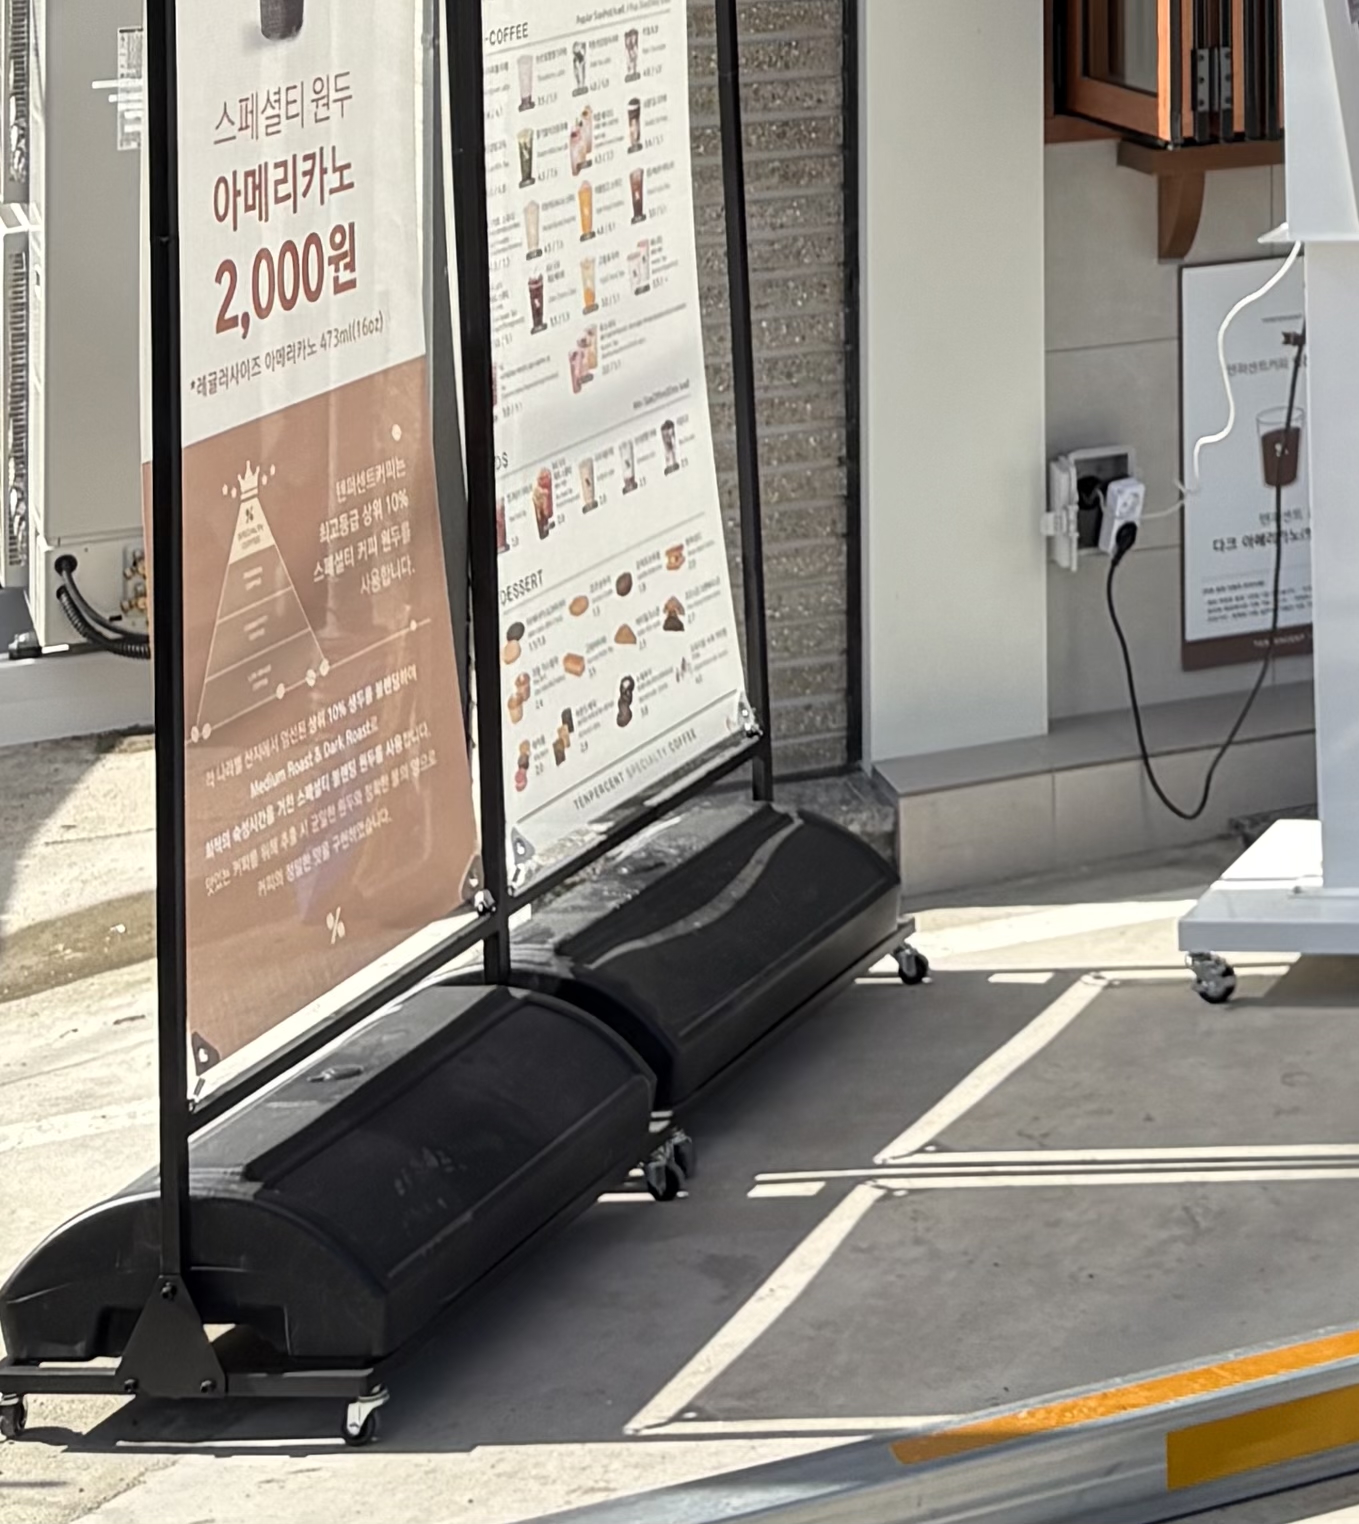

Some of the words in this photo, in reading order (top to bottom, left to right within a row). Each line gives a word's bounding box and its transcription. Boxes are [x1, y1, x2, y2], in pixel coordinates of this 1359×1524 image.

[213, 80, 304, 146] 스페셜티
[310, 70, 354, 122] 원두
[213, 144, 356, 233] 아메리카노
[214, 220, 358, 340] 2,000원
[264, 338, 318, 372] 아메리카노
[385, 488, 410, 515] 10%
[357, 530, 379, 562] 커피
[249, 762, 287, 797] Medium
[322, 732, 344, 758] Dark
